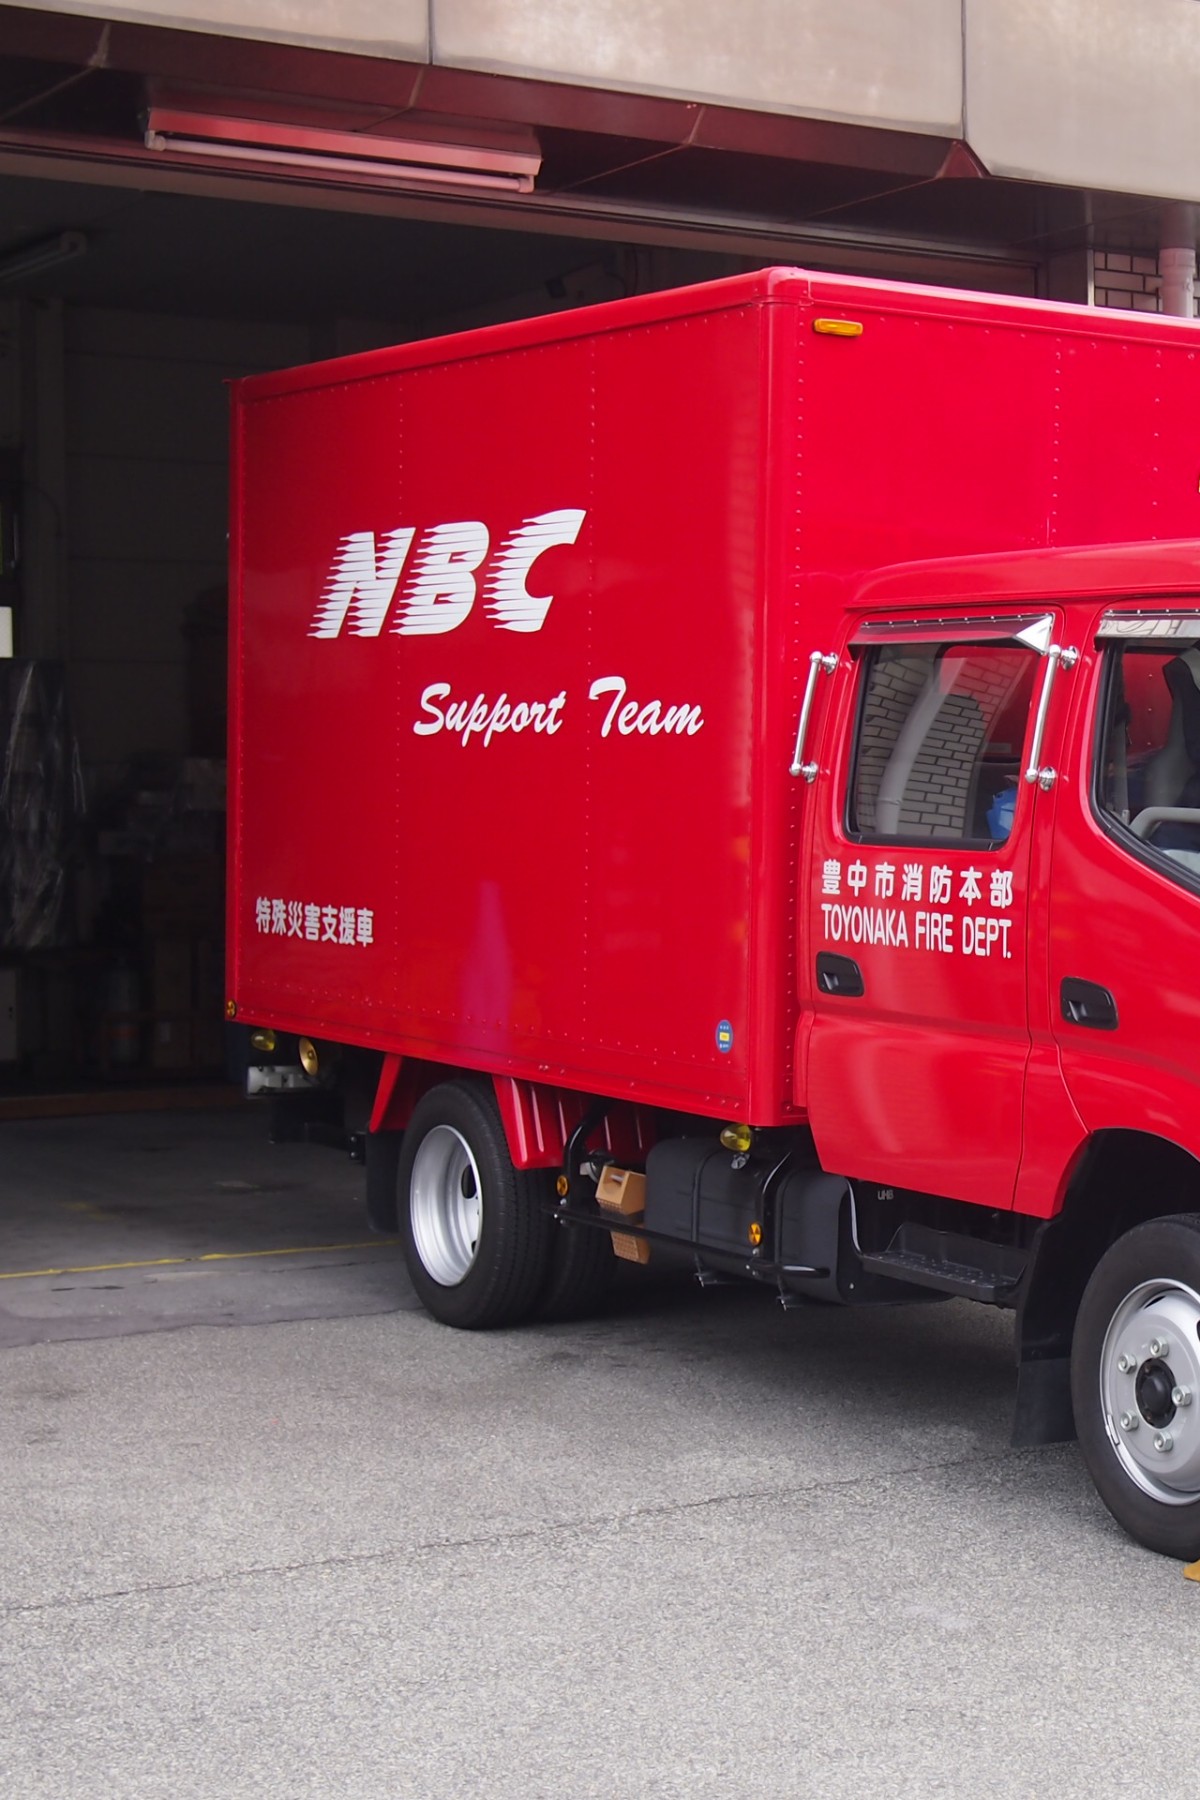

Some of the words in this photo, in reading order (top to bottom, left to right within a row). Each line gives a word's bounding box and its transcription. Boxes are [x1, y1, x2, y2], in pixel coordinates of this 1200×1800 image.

[306, 509, 587, 639] NBC
[413, 682, 567, 747] Support
[589, 676, 704, 738] Team
[822, 859, 1013, 909] 豊中市消防本部
[255, 896, 374, 947] 特殊災害支援車
[821, 904, 909, 948] TOYONAKA
[915, 911, 954, 953] FIRE
[962, 916, 1012, 959] DEPT.
